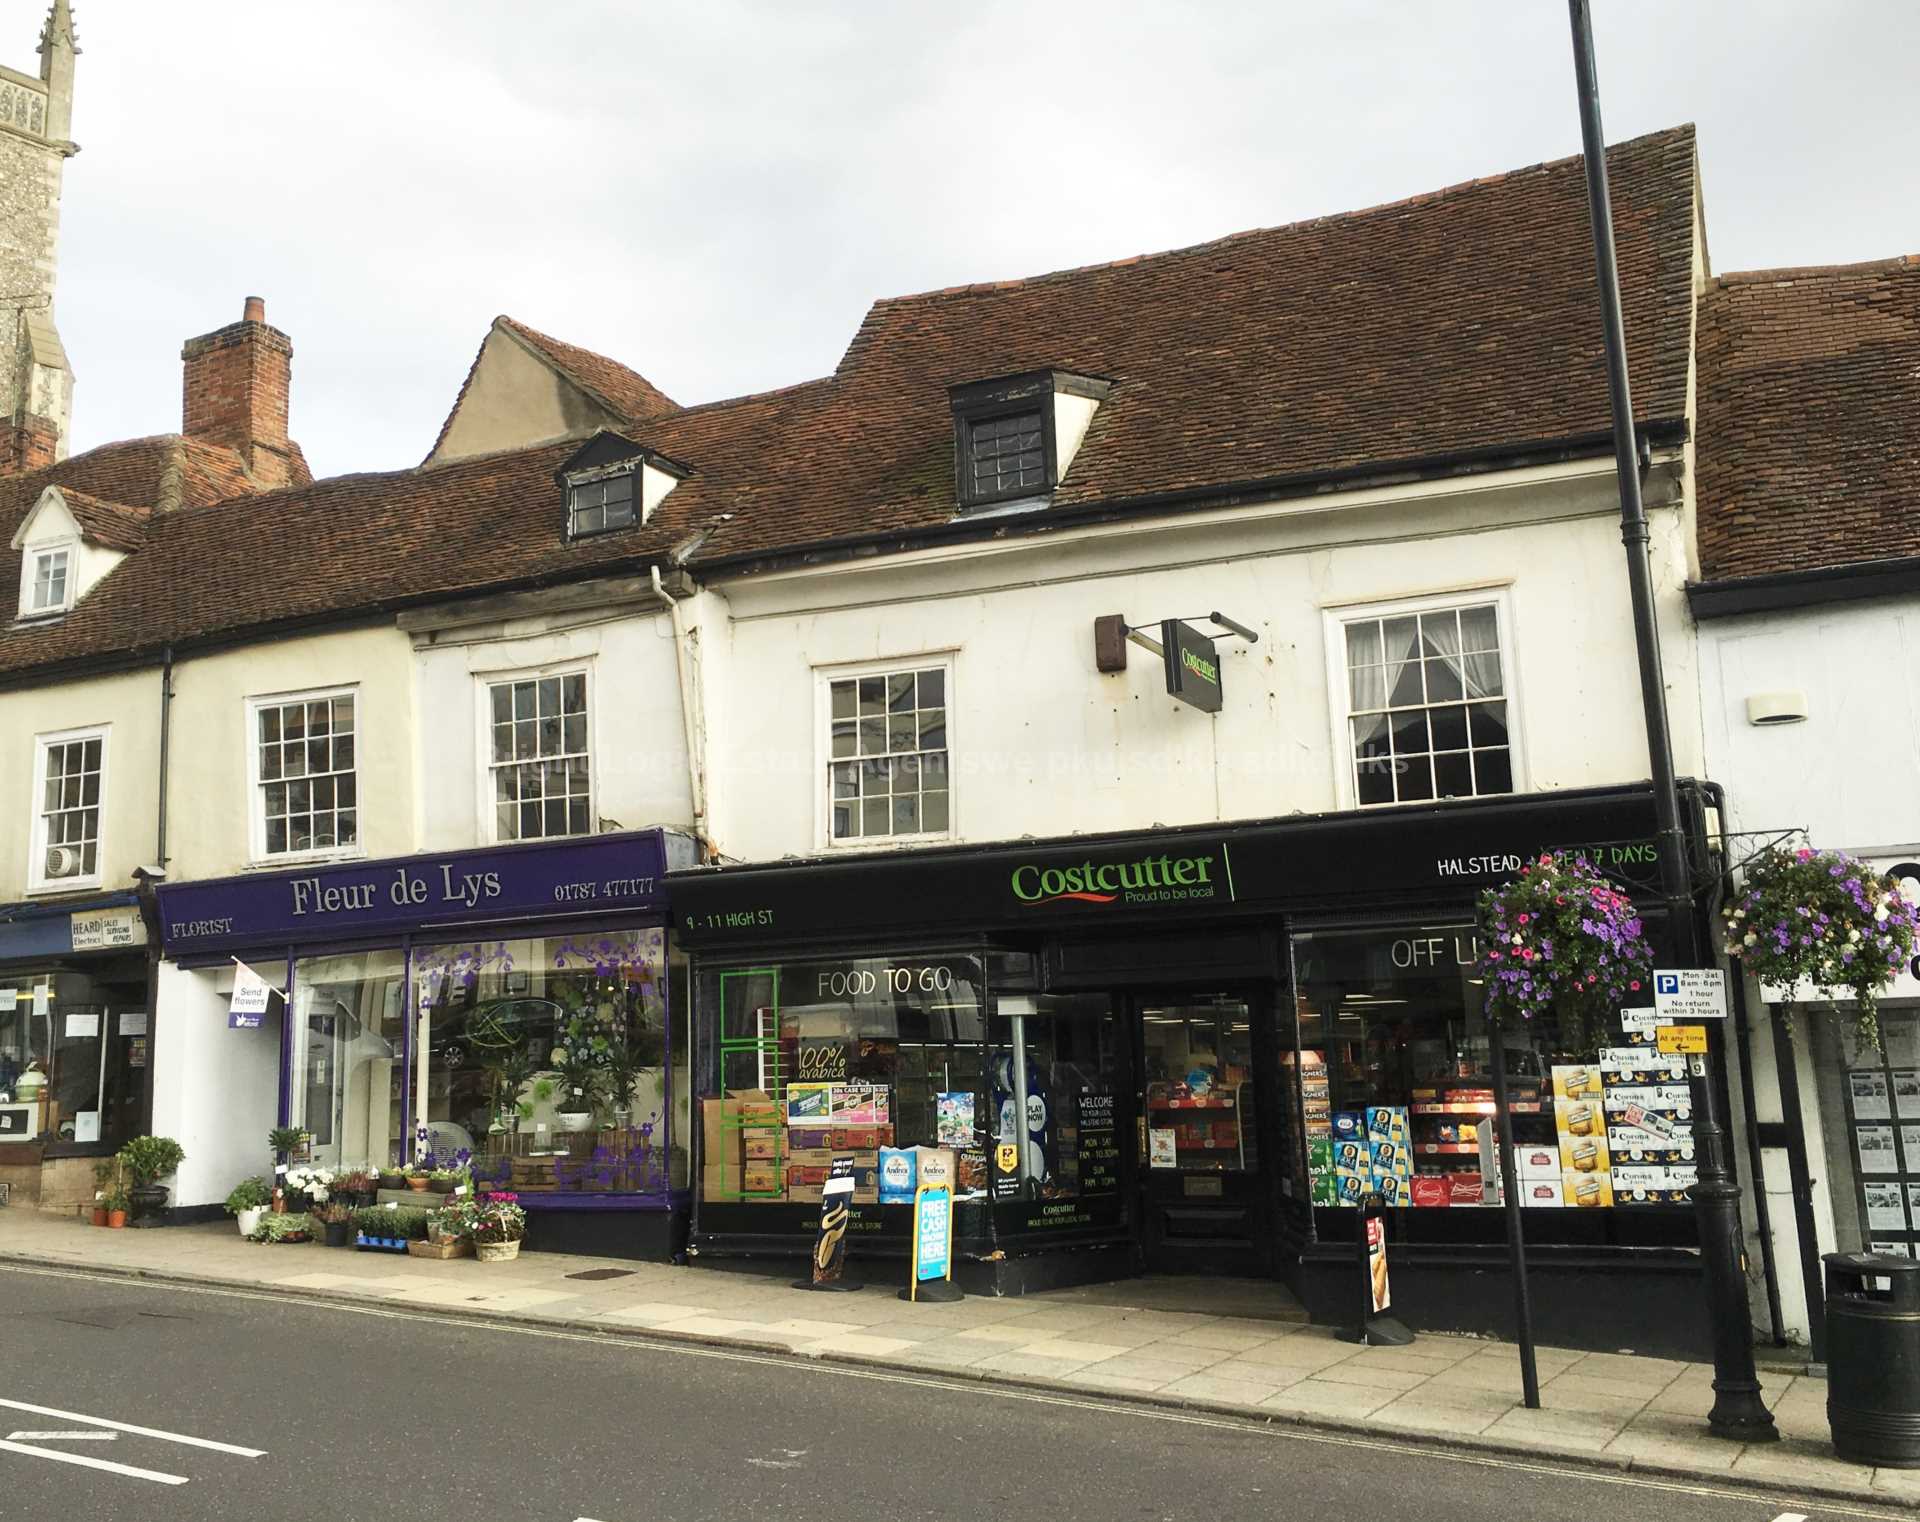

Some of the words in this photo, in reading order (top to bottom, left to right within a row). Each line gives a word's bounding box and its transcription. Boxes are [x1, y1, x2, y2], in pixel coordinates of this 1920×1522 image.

[1611, 845, 1658, 865] DAYS
[1437, 855, 1522, 877] HALSTEAD
[1012, 855, 1214, 901] Costcutter
[290, 877, 377, 916] Fleur
[390, 868, 428, 905] de
[440, 863, 502, 908] Lys
[554, 882, 597, 902] 01787
[603, 877, 655, 898] 477177
[1125, 889, 1156, 903] Proud
[1159, 889, 1171, 901] to
[1173, 888, 1187, 899] be
[1189, 885, 1215, 898] local
[73, 921, 100, 934] HEARD
[171, 917, 233, 939] FLORIST
[686, 916, 694, 930] 9
[706, 914, 722, 929] 11
[726, 910, 756, 927] HIGH
[758, 909, 774, 925] ST
[1391, 938, 1445, 968] OFF
[818, 969, 876, 997] FOOD
[883, 967, 912, 994] TO
[919, 966, 952, 992] GO
[240, 986, 263, 997] Send
[234, 997, 265, 1006] flowers
[1671, 1035, 1683, 1043] any
[799, 1045, 845, 1069] 100%
[799, 1065, 846, 1080] arabica
[1693, 1063, 1701, 1074] 9
[1027, 1105, 1042, 1113] PLAY
[1079, 1097, 1113, 1108] WELCOME
[1028, 1113, 1042, 1122] NOW
[886, 1166, 908, 1175] Andrex
[924, 1166, 946, 1175] Andrex
[921, 1200, 947, 1218] FREE
[921, 1215, 947, 1234] CASH
[921, 1242, 947, 1262] HERE
